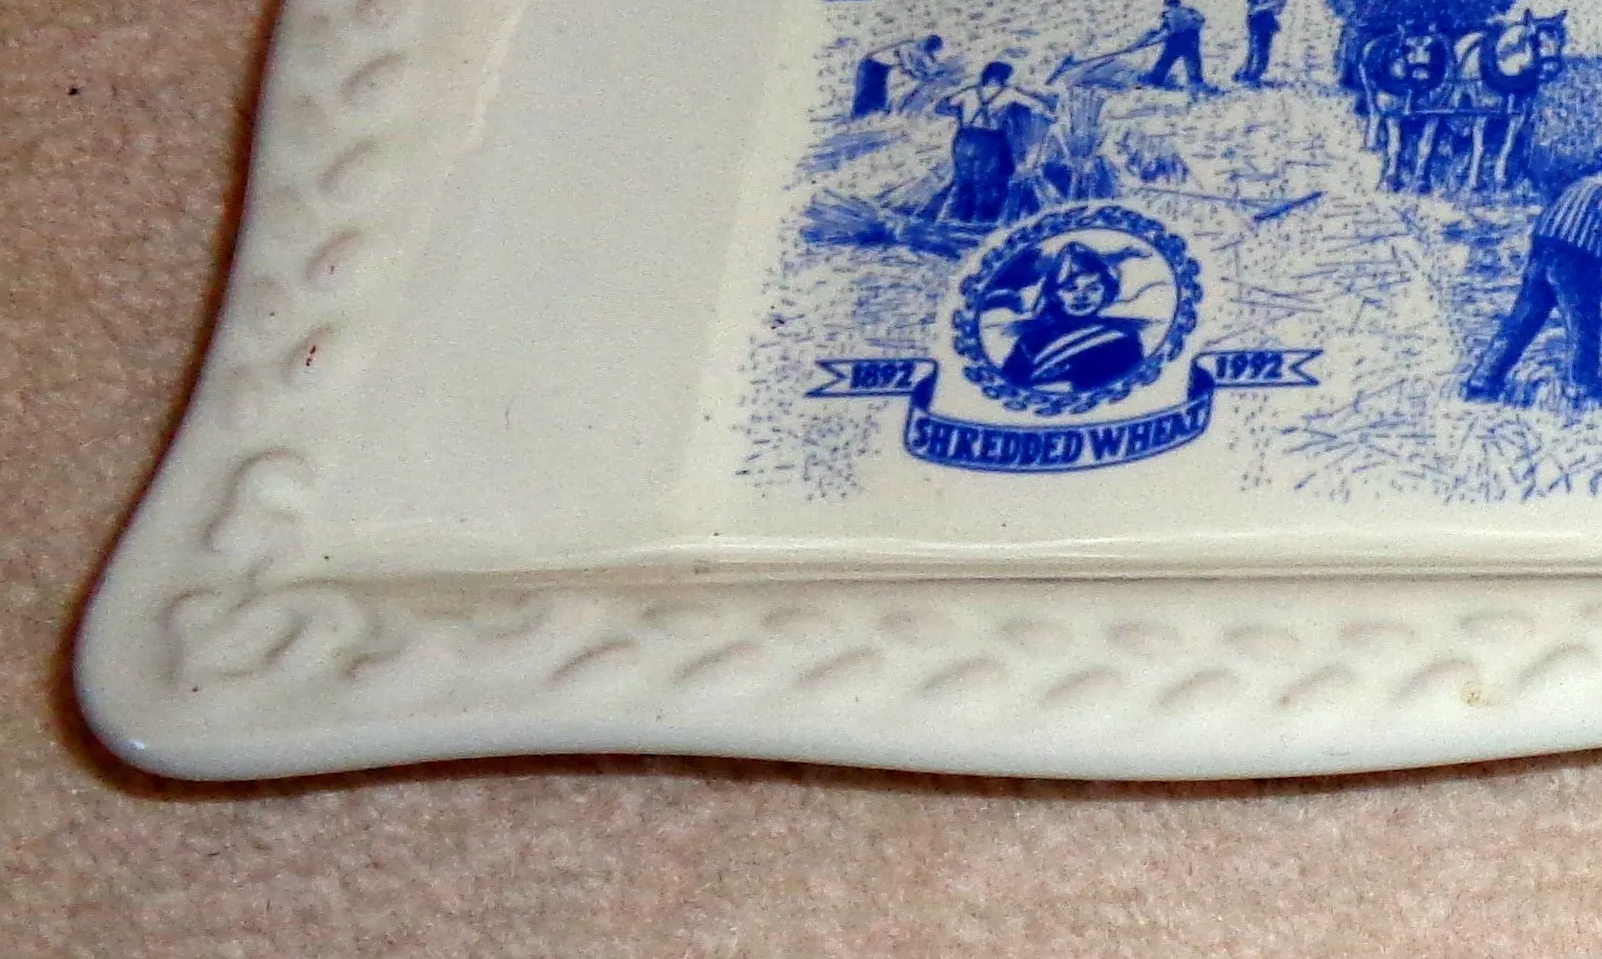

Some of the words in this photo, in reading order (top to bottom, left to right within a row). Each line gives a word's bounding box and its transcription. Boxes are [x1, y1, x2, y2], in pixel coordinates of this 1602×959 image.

[850, 362, 917, 389] 1892
[1214, 353, 1285, 380] 1992
[912, 416, 1083, 465] SHREDDED
[1086, 403, 1209, 458] WHEAT
